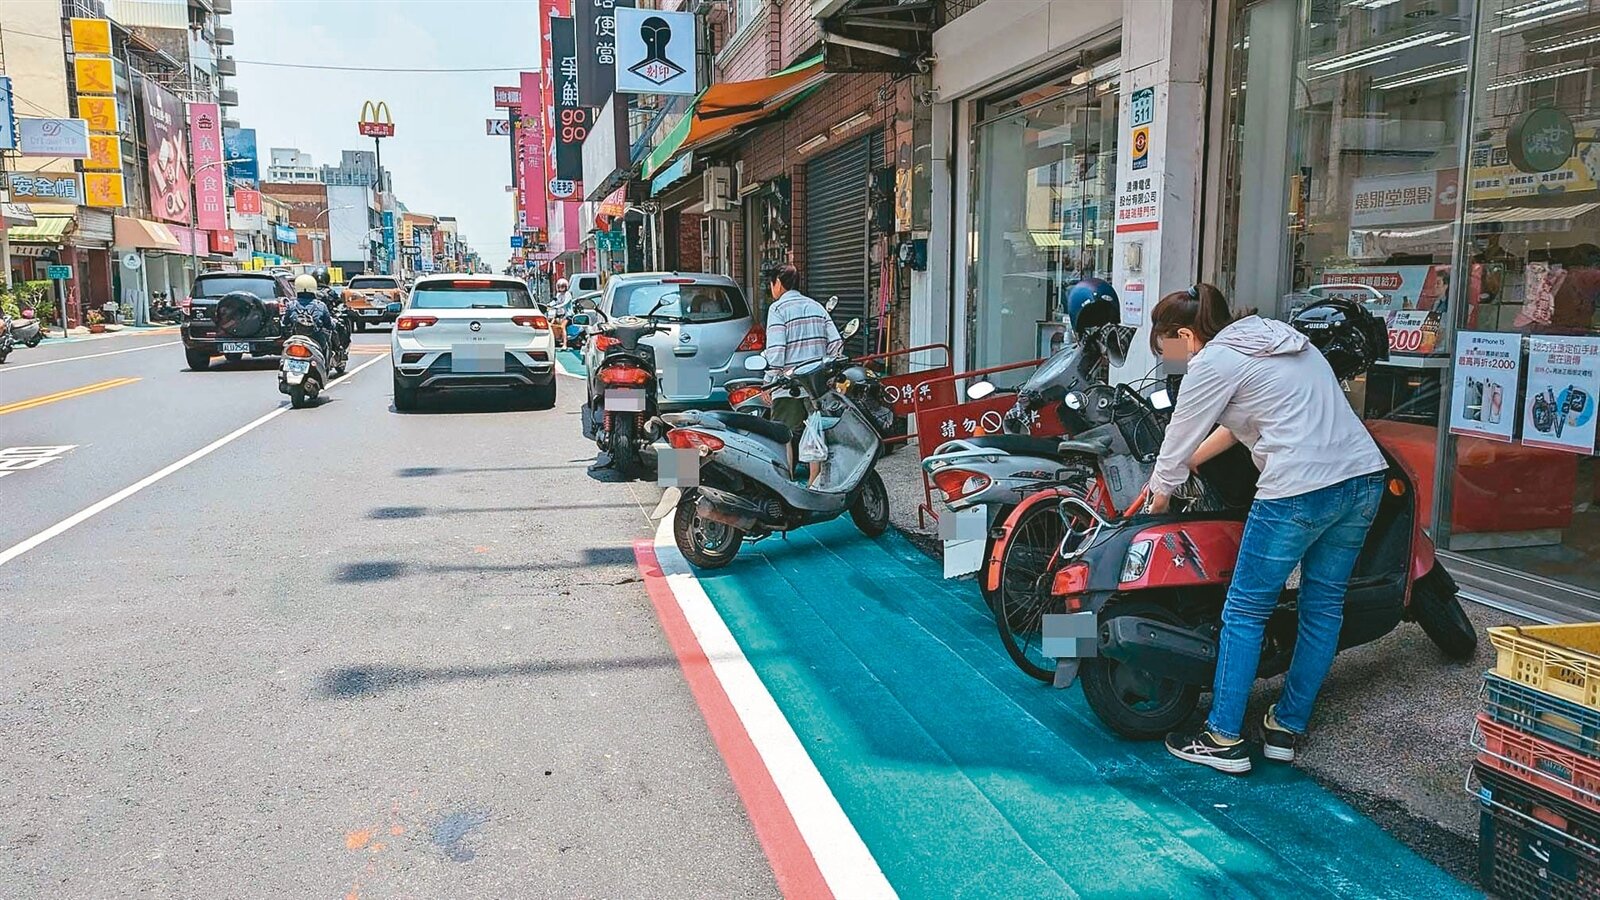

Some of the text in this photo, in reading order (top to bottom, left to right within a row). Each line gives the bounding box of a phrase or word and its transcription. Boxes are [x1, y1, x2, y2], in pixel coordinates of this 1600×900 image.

[646, 65, 669, 79] 刻印
[562, 109, 585, 126] go
[1134, 107, 1150, 124] 511
[562, 126, 586, 143] go
[199, 135, 219, 212] 義美食品
[12, 177, 76, 198] 安全帽
[1126, 177, 1151, 193] 遠傳電信
[1119, 191, 1157, 206] 股份有限公司
